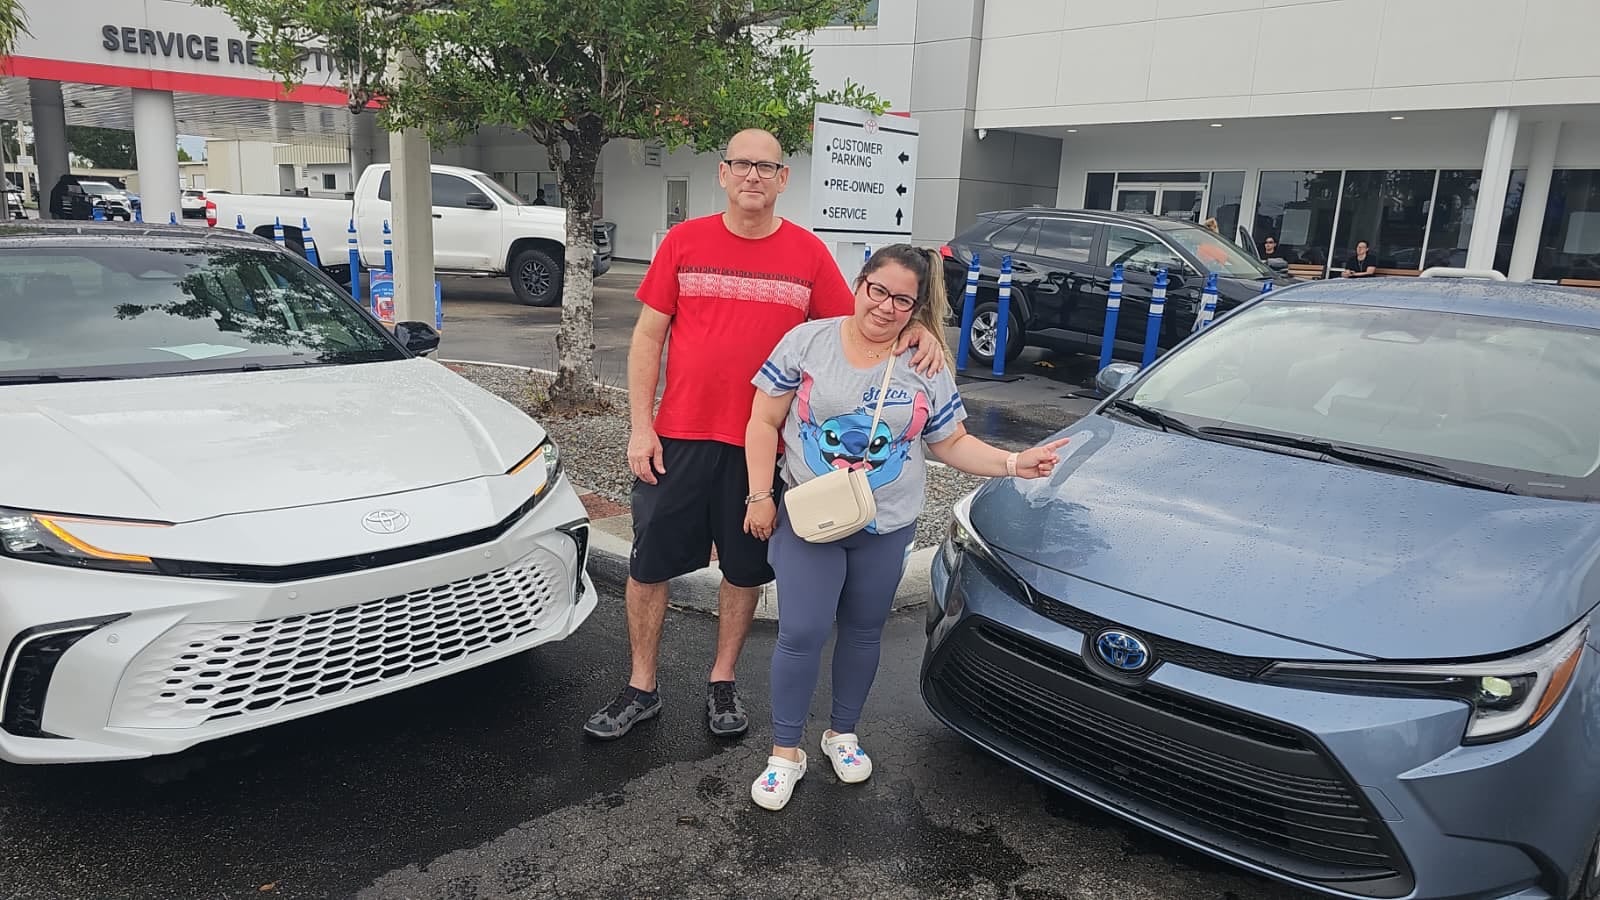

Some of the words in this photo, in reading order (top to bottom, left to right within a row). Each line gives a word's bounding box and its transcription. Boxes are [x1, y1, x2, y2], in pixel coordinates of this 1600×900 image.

[101, 25, 220, 62] SERVICE
[832, 137, 883, 155] CUSTOMER
[831, 152, 872, 168] PARKING
[830, 178, 885, 195] PRE-OWNED
[828, 206, 867, 220] SERVICE
[863, 386, 907, 401] Sttch
